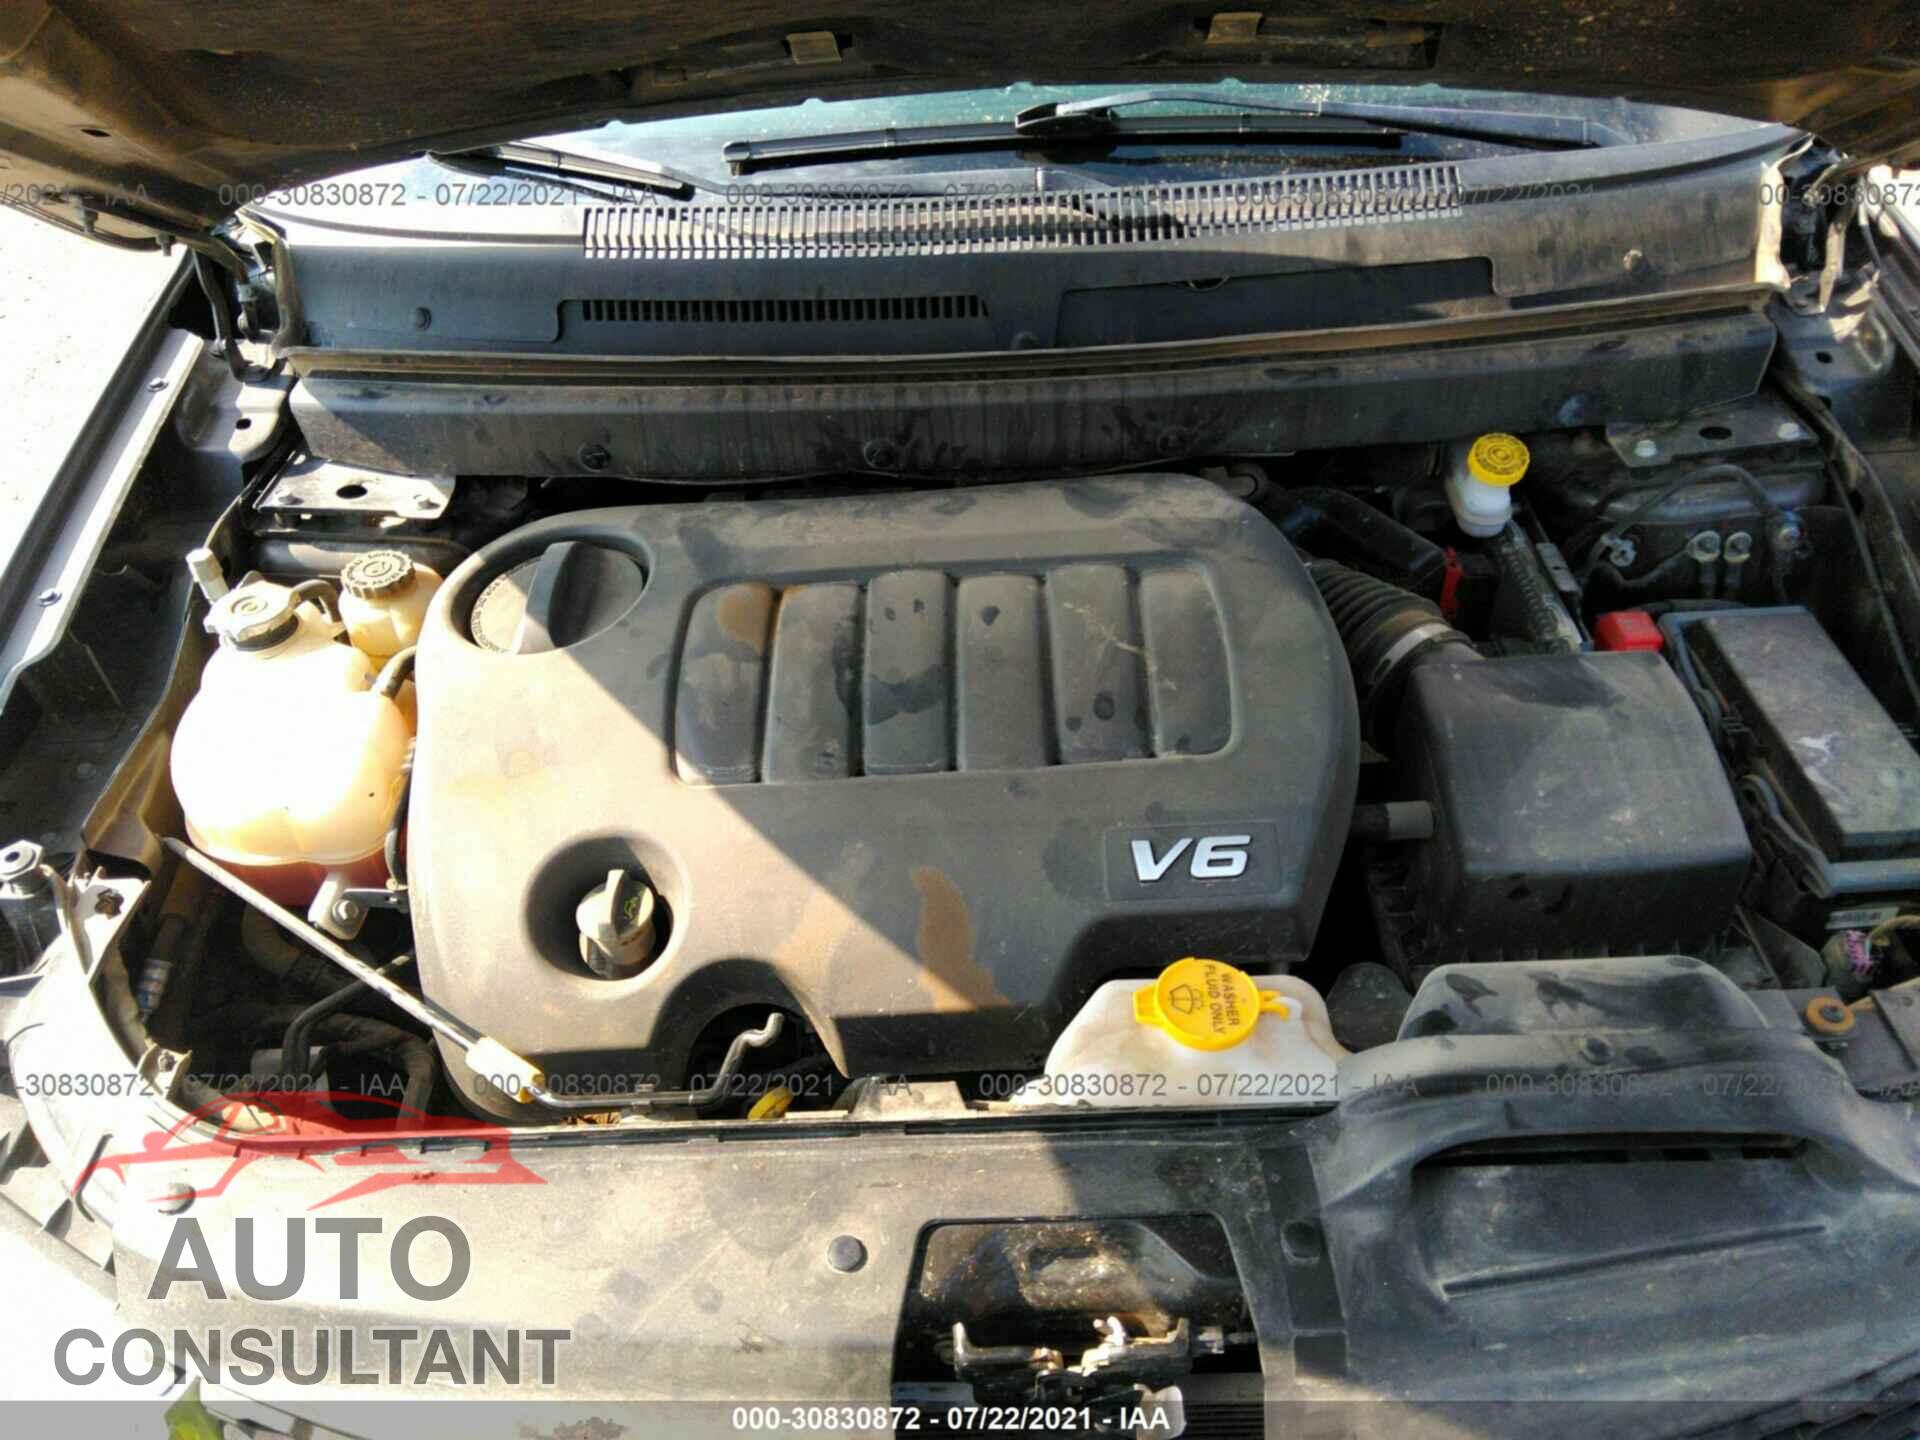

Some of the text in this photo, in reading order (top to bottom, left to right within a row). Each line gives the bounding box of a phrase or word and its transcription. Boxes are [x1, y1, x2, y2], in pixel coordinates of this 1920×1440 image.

[1131, 835, 1250, 881] V6
[1205, 964, 1226, 1034] FLUID ONLY
[1221, 973, 1241, 1026] WASHER
